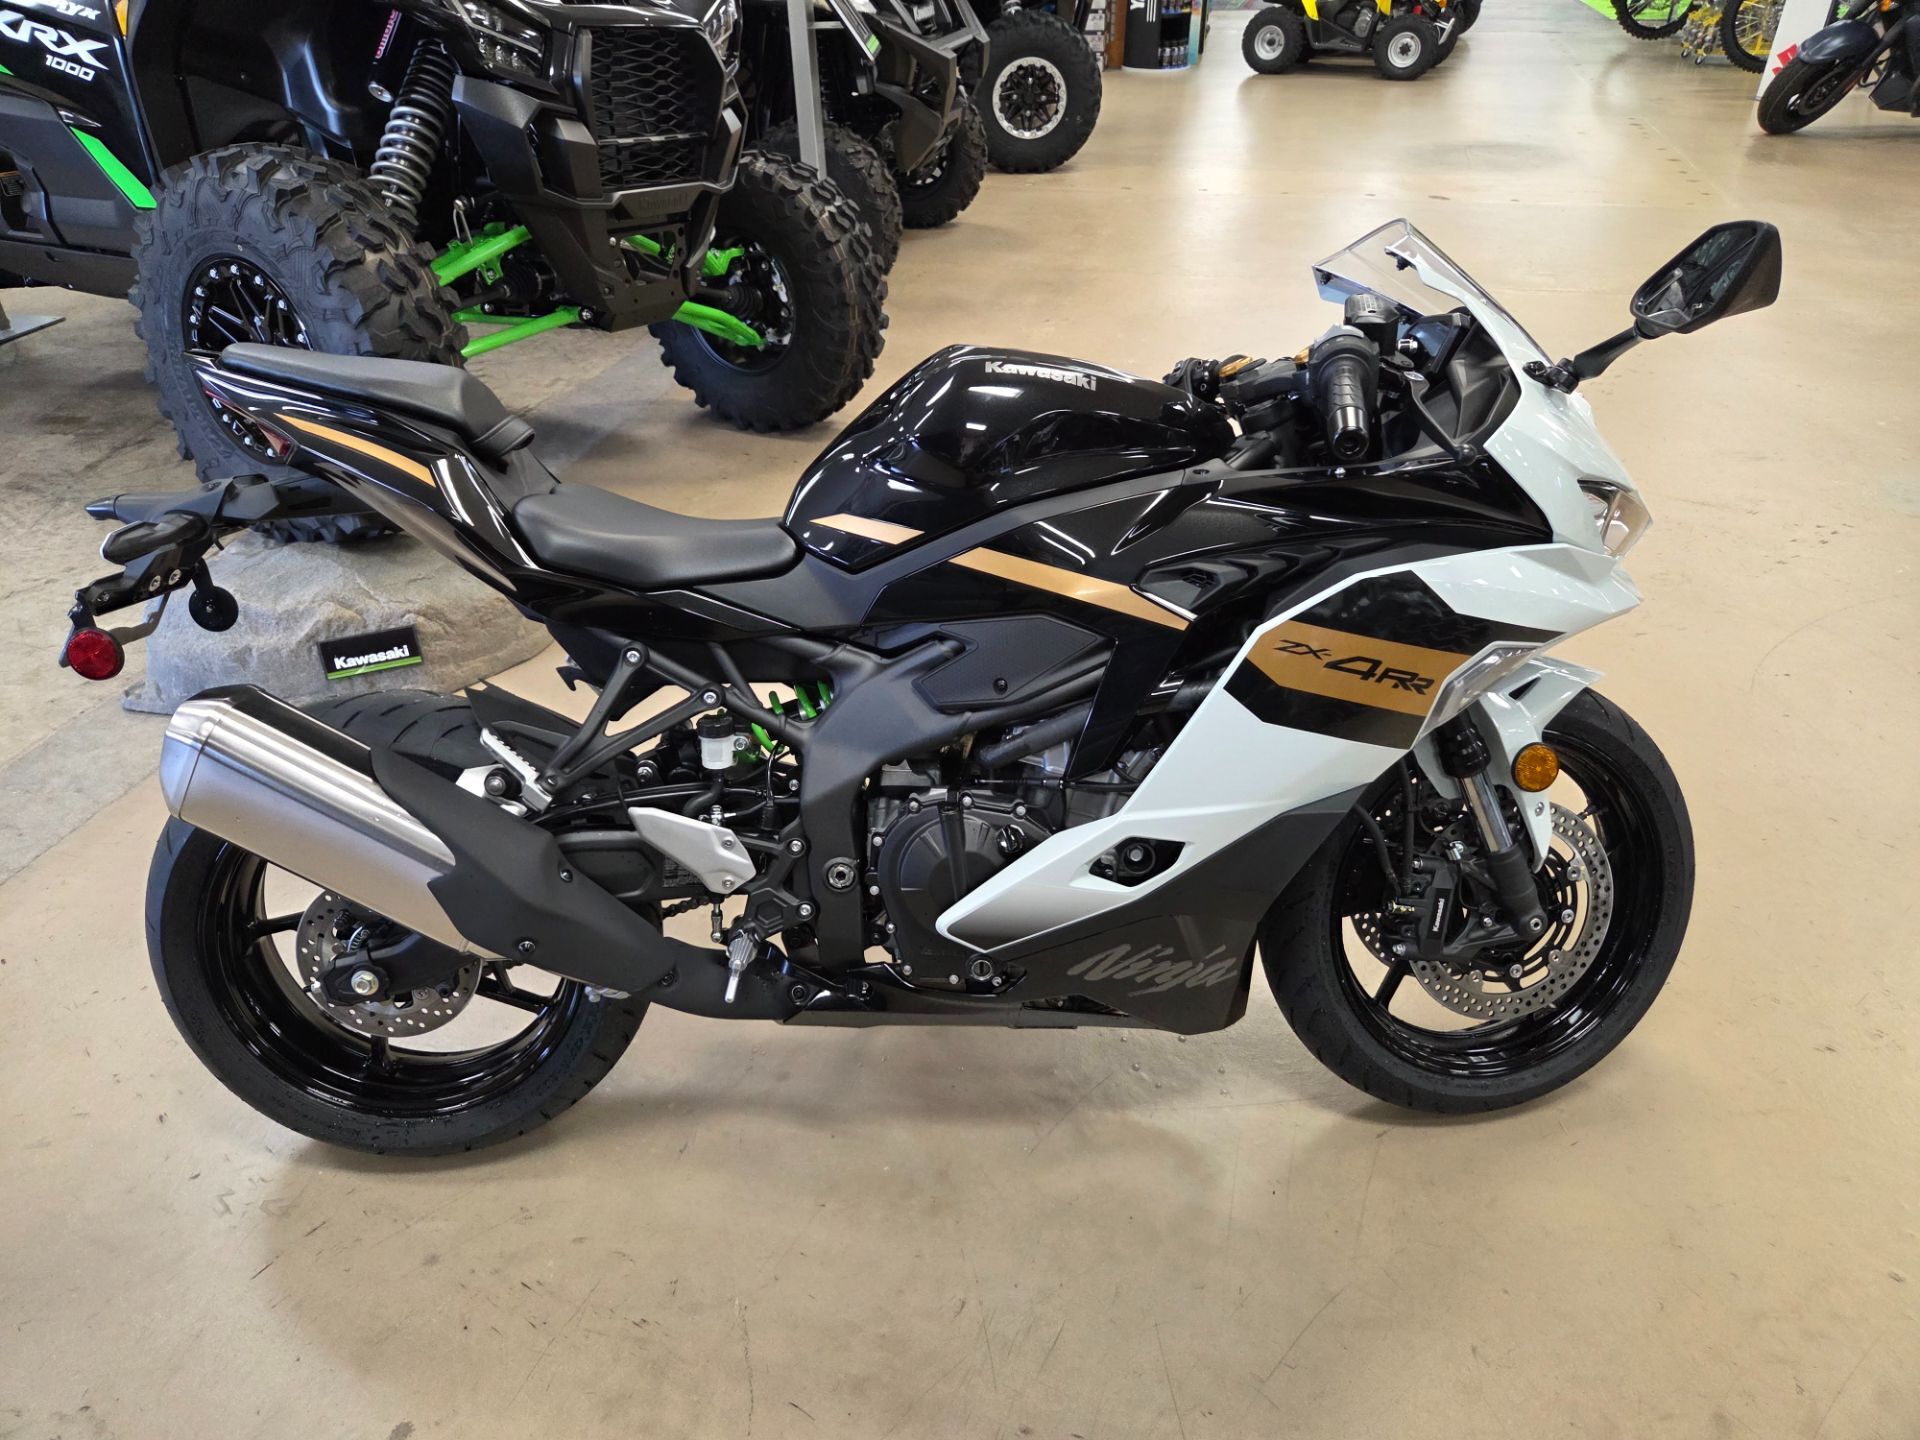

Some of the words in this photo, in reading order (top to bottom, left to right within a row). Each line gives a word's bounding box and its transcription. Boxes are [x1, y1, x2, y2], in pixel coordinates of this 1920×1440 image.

[45, 54, 96, 81] 1000
[984, 361, 1097, 391] Kawasaki
[333, 645, 410, 670] Kawasaki
[1066, 943, 1238, 998] Ninja
